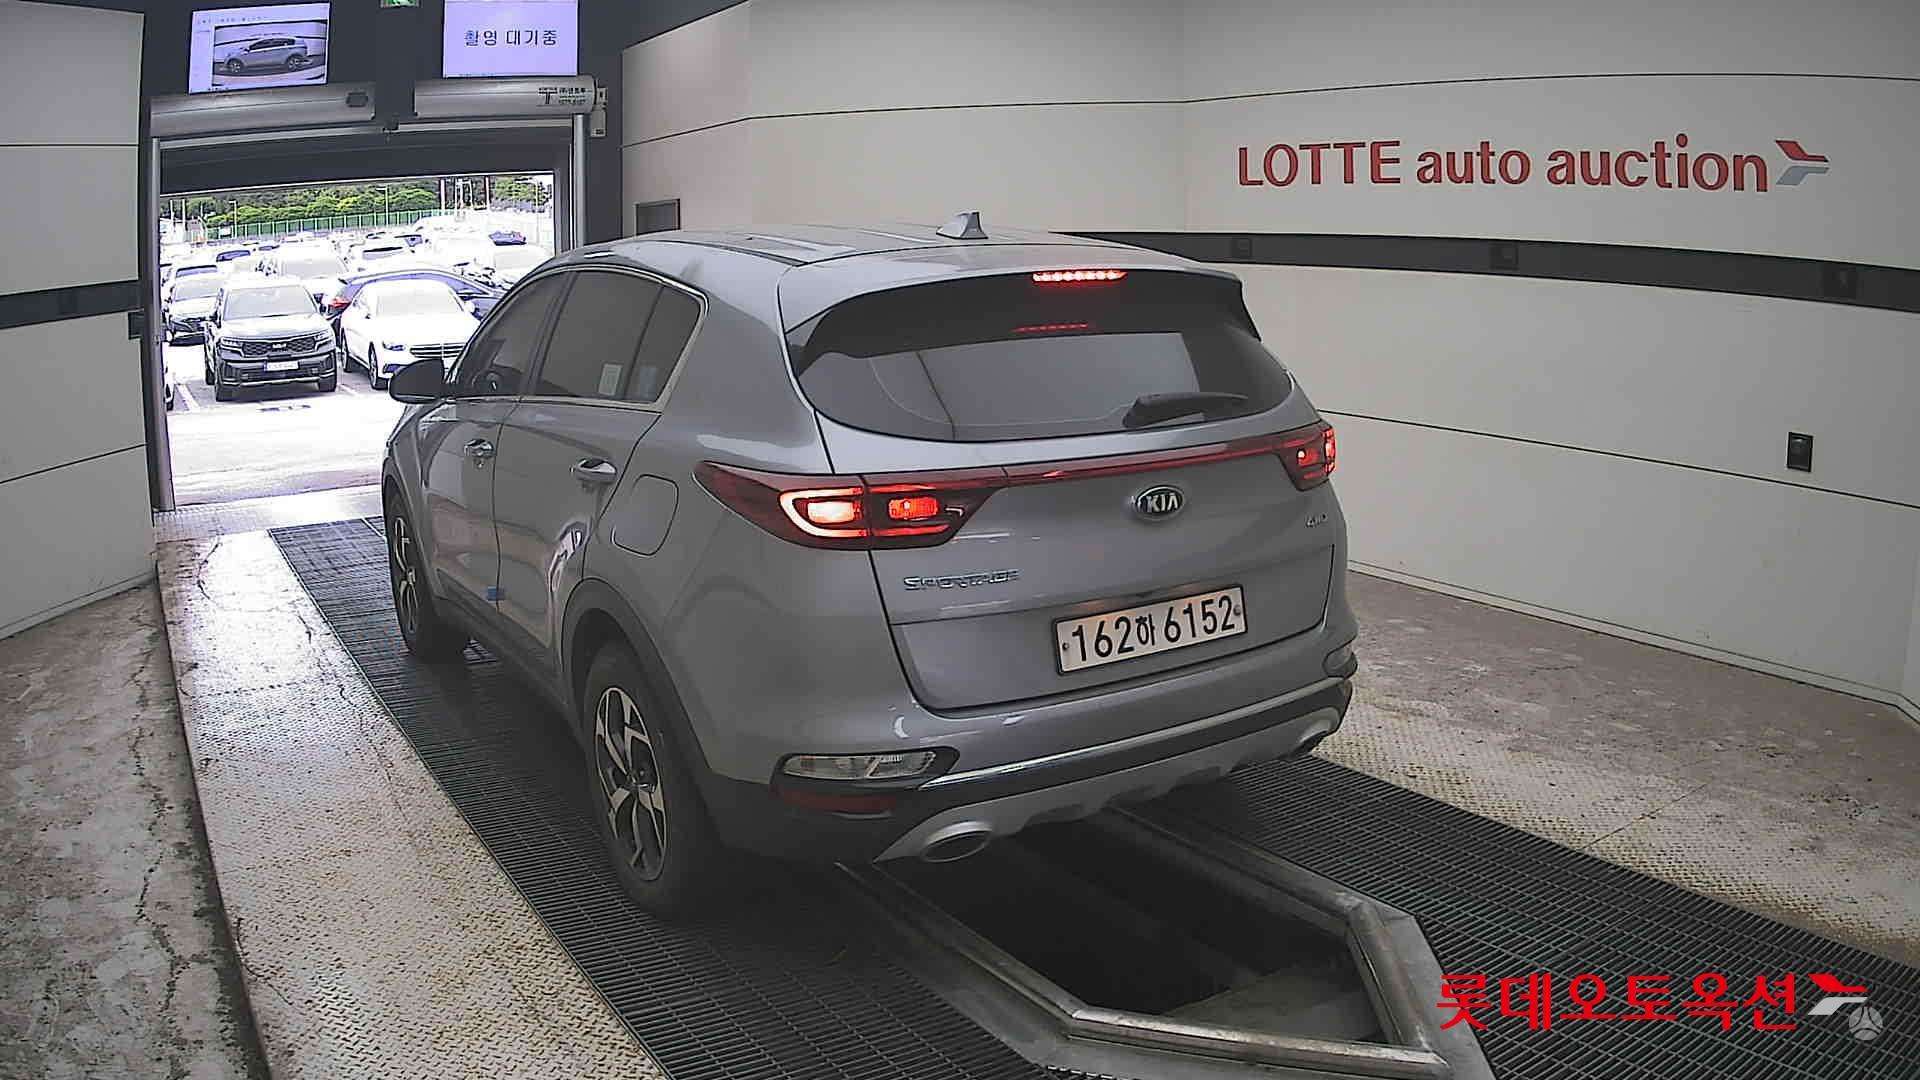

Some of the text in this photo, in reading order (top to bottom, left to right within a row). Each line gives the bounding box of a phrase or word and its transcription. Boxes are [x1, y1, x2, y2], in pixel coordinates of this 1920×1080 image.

[505, 29, 557, 46] 대기중
[1238, 133, 1768, 192] LOTTE auto auction
[1146, 493, 1179, 513] KIA
[1072, 594, 1235, 662] 162하 6152
